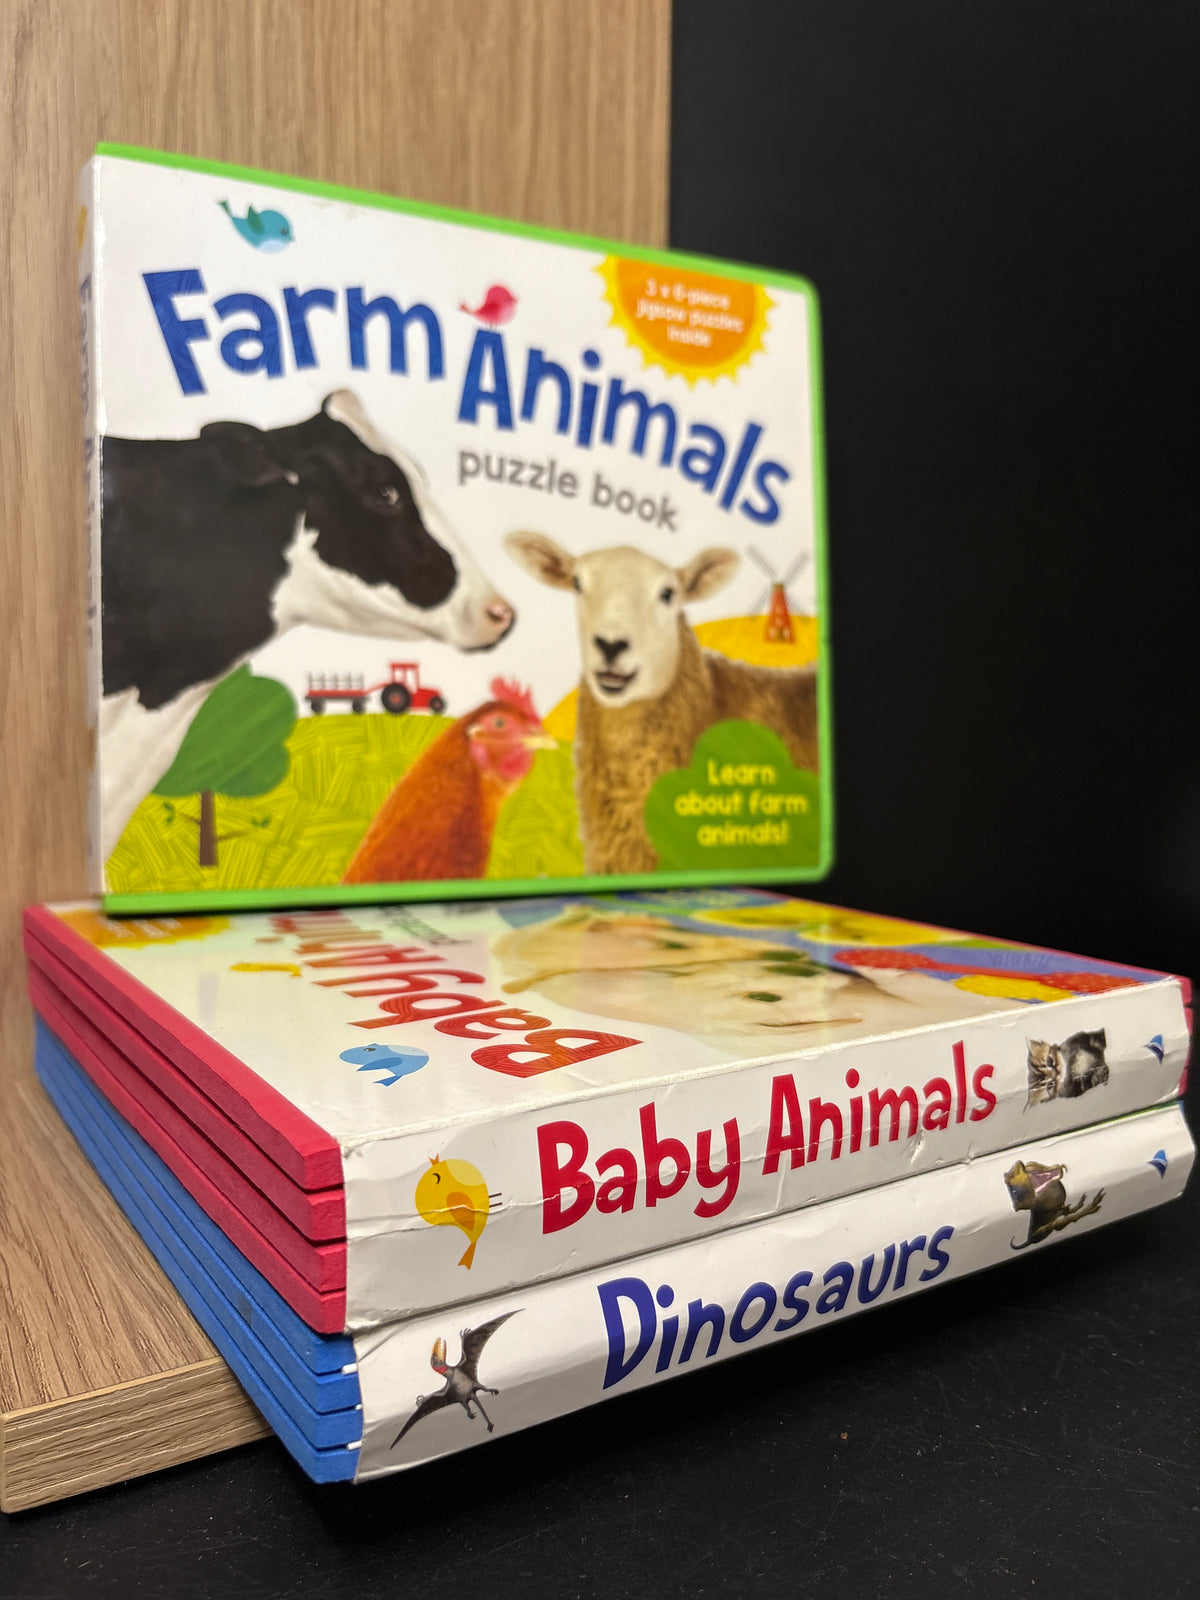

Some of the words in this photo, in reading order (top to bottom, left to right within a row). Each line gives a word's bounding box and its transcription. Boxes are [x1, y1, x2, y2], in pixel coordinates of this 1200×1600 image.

[142, 268, 446, 396] Farm
[457, 328, 792, 526] Animals
[458, 449, 578, 498] puzzle
[592, 473, 678, 532] book
[674, 789, 743, 816] about
[748, 790, 809, 816] farm
[707, 758, 776, 786] Learn
[697, 819, 790, 847] animals!
[312, 968, 644, 1078] Baby
[536, 1102, 741, 1234] Baby
[761, 1040, 998, 1176] Animals
[597, 1225, 955, 1390] Dinosaurs
